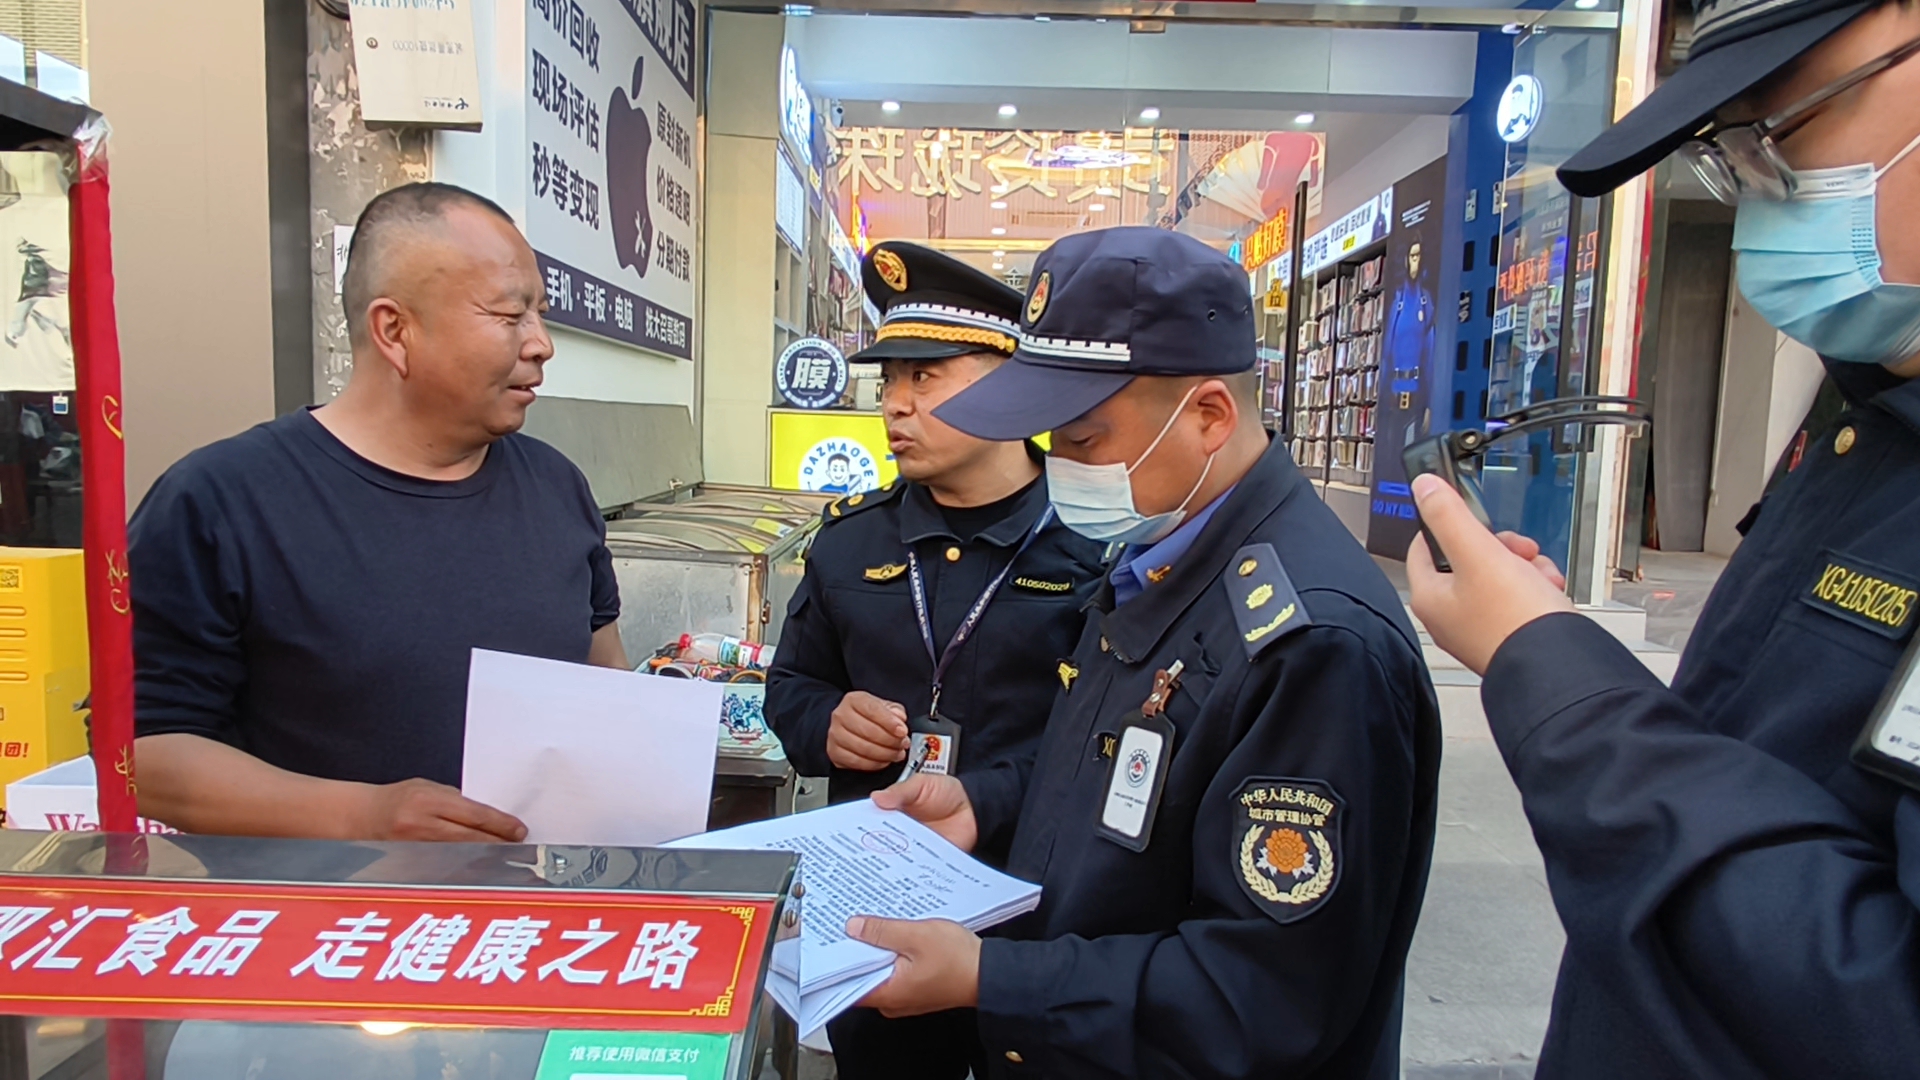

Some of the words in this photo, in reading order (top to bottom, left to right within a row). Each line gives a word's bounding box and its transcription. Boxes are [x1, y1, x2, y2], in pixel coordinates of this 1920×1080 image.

[532, 47, 599, 154] 现场评估
[657, 100, 691, 169] 原封新机
[532, 141, 600, 231] 秒等变现
[657, 164, 691, 227] 价格透明
[656, 230, 691, 283] 分期付款
[791, 358, 832, 389] 膜
[803, 442, 874, 477] DAZHAOGE
[1240, 787, 1334, 816] 中华人民共和国
[1248, 806, 1326, 827] 城市管理协管
[289, 911, 703, 990] 走健康之路
[568, 1045, 701, 1064] 推荐使用微信支付
